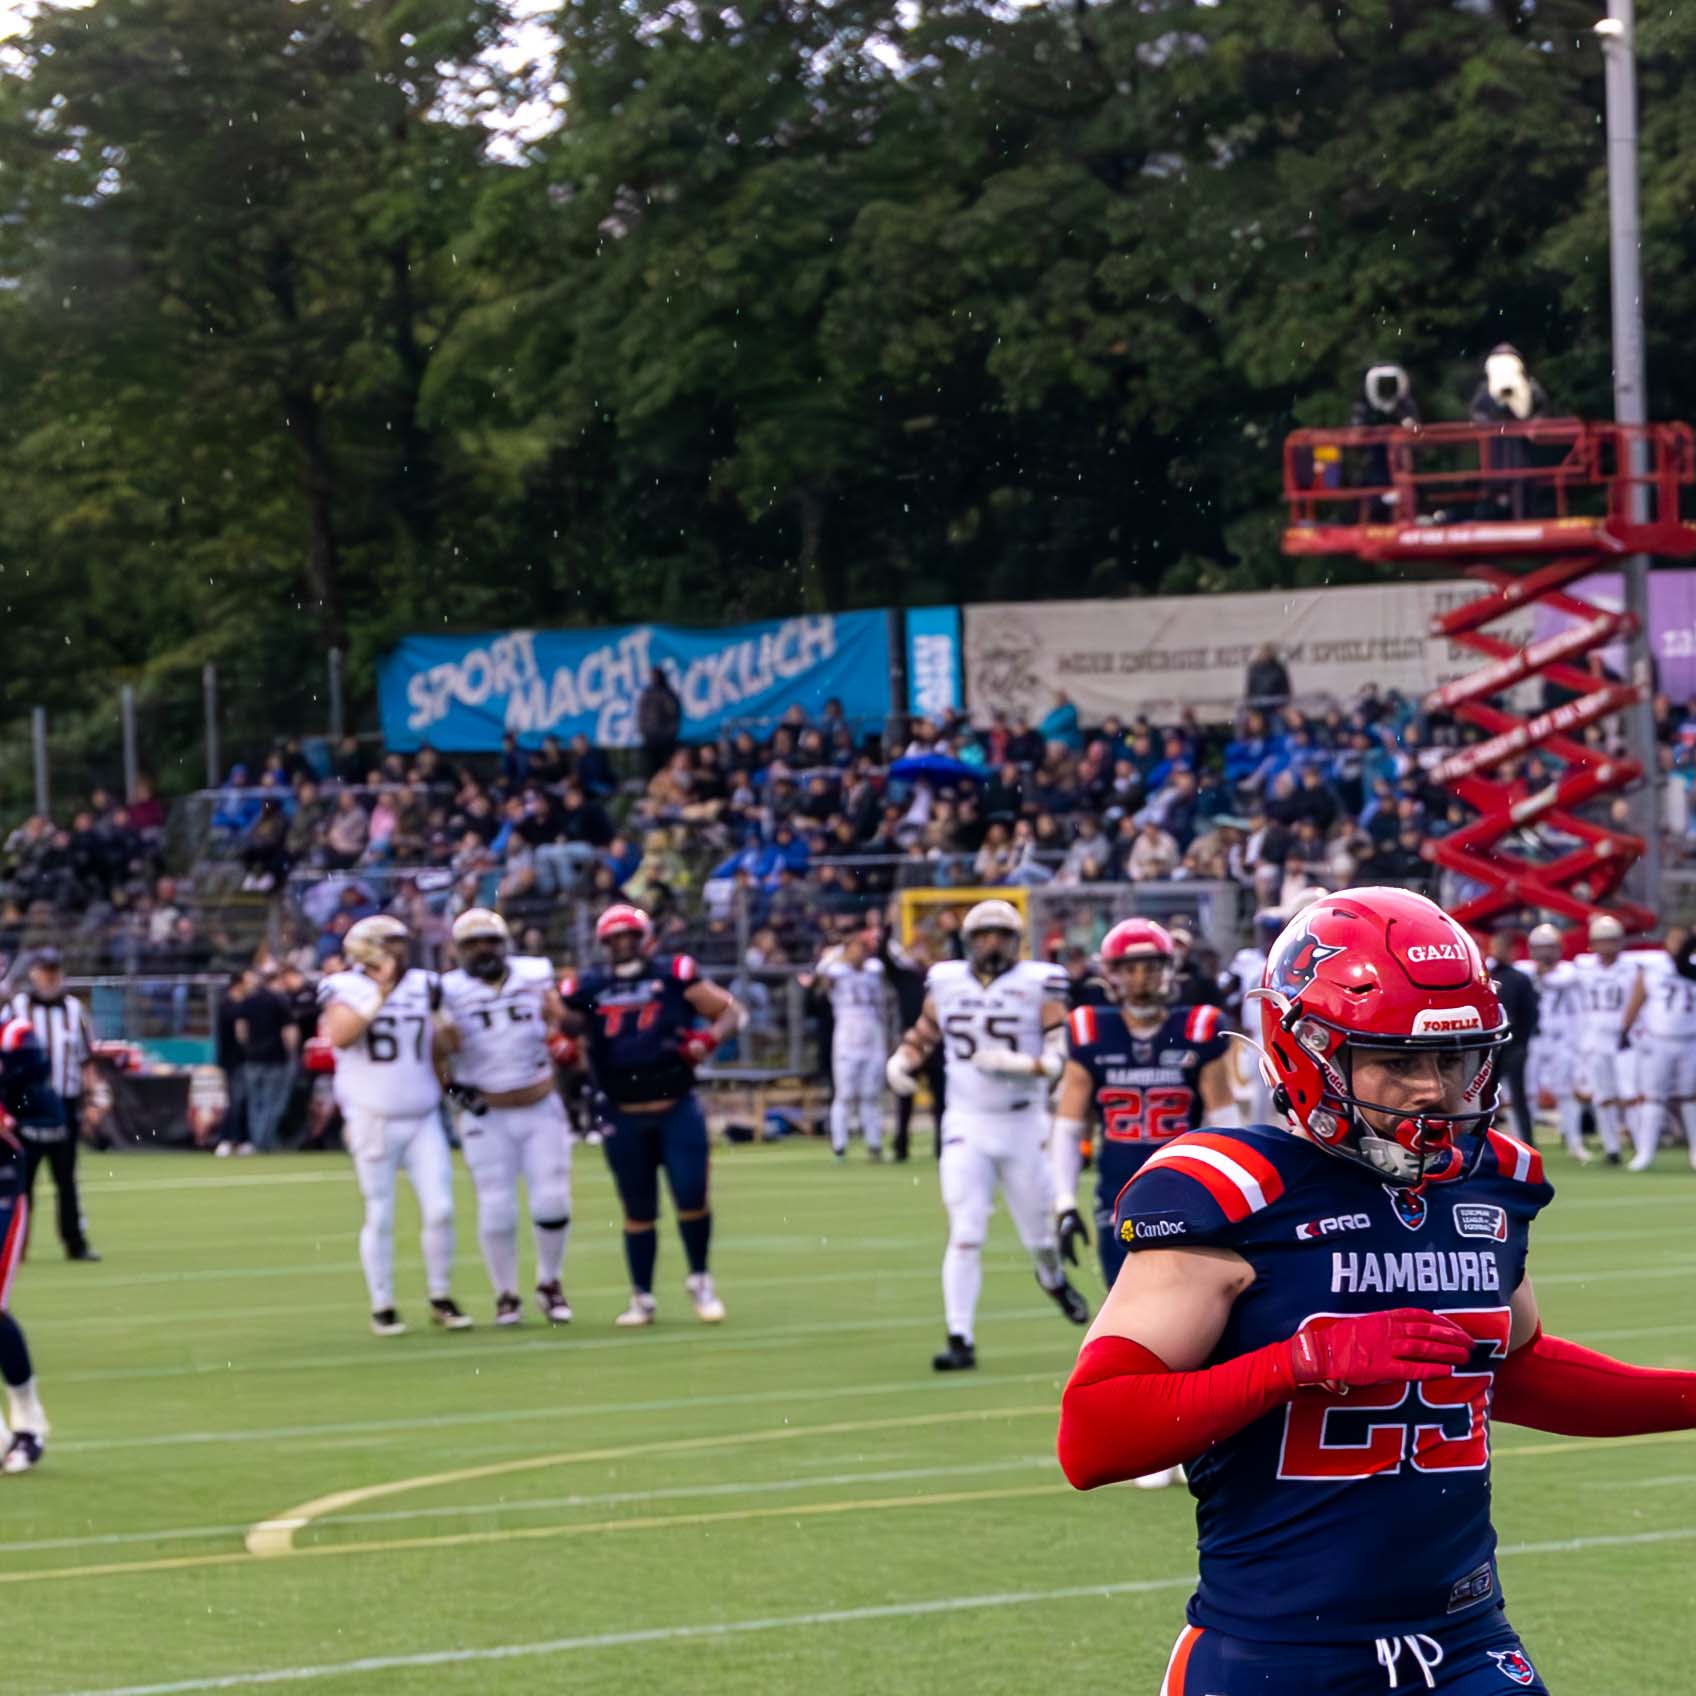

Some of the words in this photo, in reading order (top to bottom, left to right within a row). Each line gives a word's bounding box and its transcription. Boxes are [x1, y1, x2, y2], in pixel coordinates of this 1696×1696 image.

[407, 629, 538, 731] SPORT
[503, 627, 655, 733] MACHT
[365, 1014, 427, 1062] 67
[946, 1015, 1019, 1060] 55
[1423, 1017, 1479, 1032] FORELLE
[1098, 1086, 1194, 1142] 22
[1136, 1220, 1186, 1238] CanDoc
[1331, 1252, 1499, 1293] HAMBURG
[1276, 1306, 1512, 1480] 25
